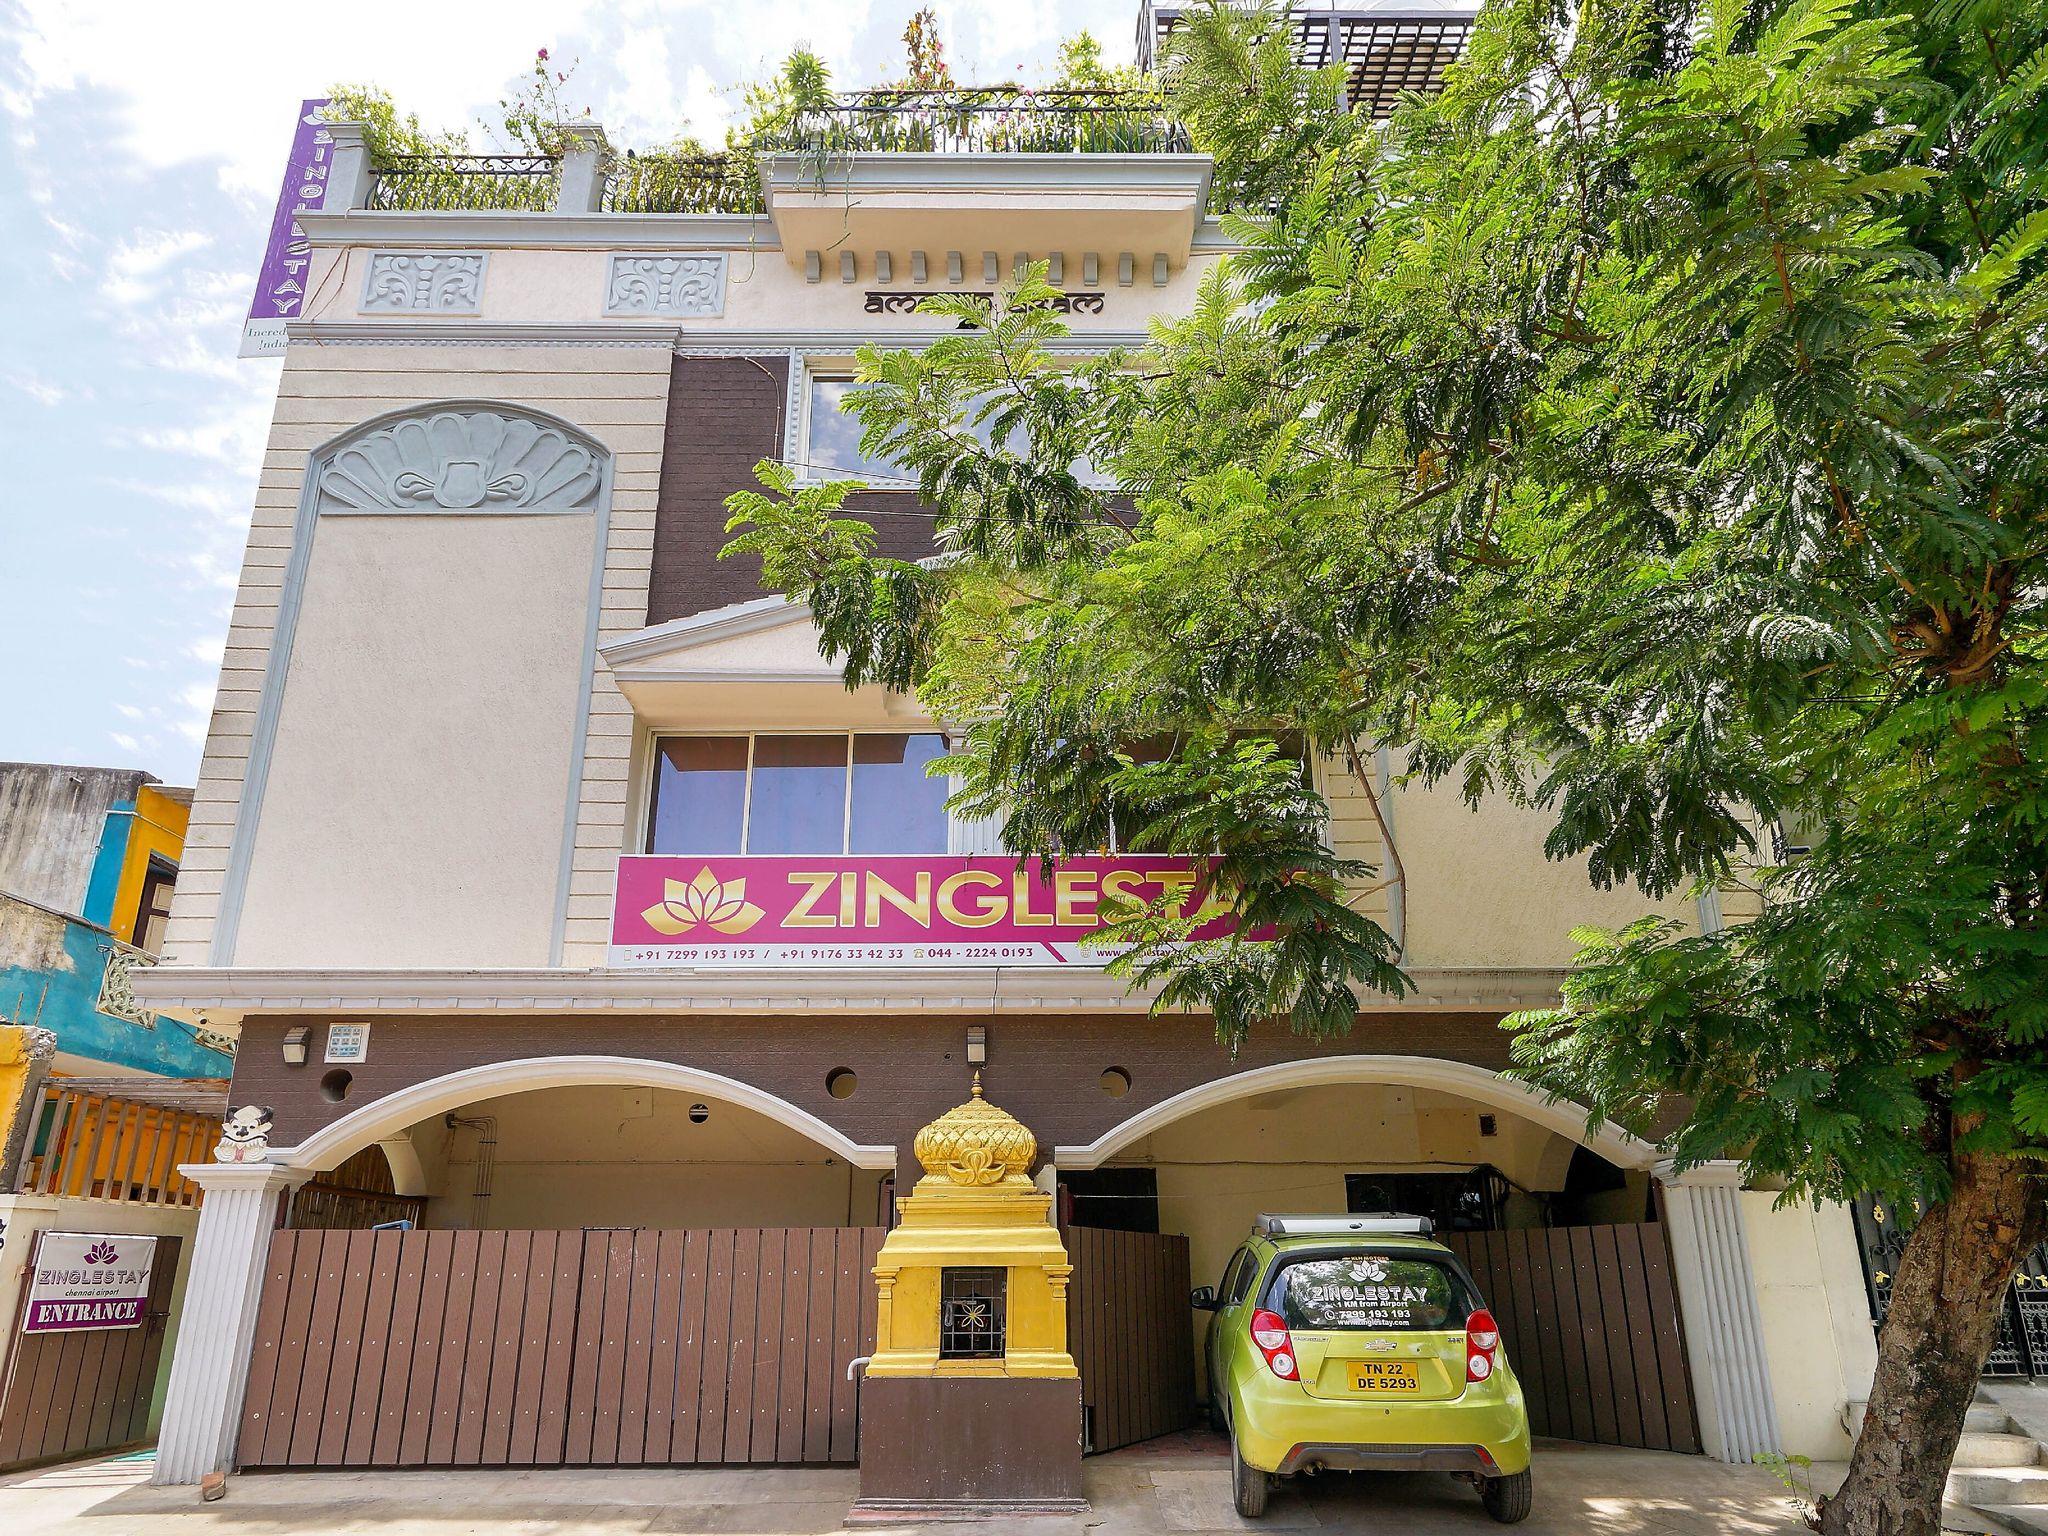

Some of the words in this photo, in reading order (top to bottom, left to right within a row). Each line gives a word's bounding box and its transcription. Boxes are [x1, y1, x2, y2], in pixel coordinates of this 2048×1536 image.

[248, 328, 288, 337] Incred
[780, 869, 1309, 929] ZINGLESTA
[635, 950, 660, 960] +91
[667, 950, 698, 960] 7299
[705, 949, 727, 959] 193
[733, 949, 755, 959] 193
[780, 949, 804, 959] +91
[811, 949, 842, 959] 9176
[847, 949, 863, 959] 33
[868, 949, 883, 959] 42
[888, 949, 904, 959] 33
[928, 948, 952, 958] 044
[966, 948, 997, 958] 2224
[1001, 947, 1033, 957] 0193
[39, 1269, 150, 1285] ZINGLESTAY
[65, 1288, 95, 1297] chennai
[95, 1288, 120, 1297] airport
[1311, 1285, 1428, 1302] ZINGLESTAY
[37, 1301, 138, 1323] ENTRANCE
[1368, 1310, 1388, 1318] 193
[1391, 1310, 1411, 1318] 193
[1364, 1364, 1383, 1375] TN
[1387, 1364, 1403, 1375] 22
[1358, 1378, 1376, 1389] DE
[1380, 1378, 1417, 1389] 5293
